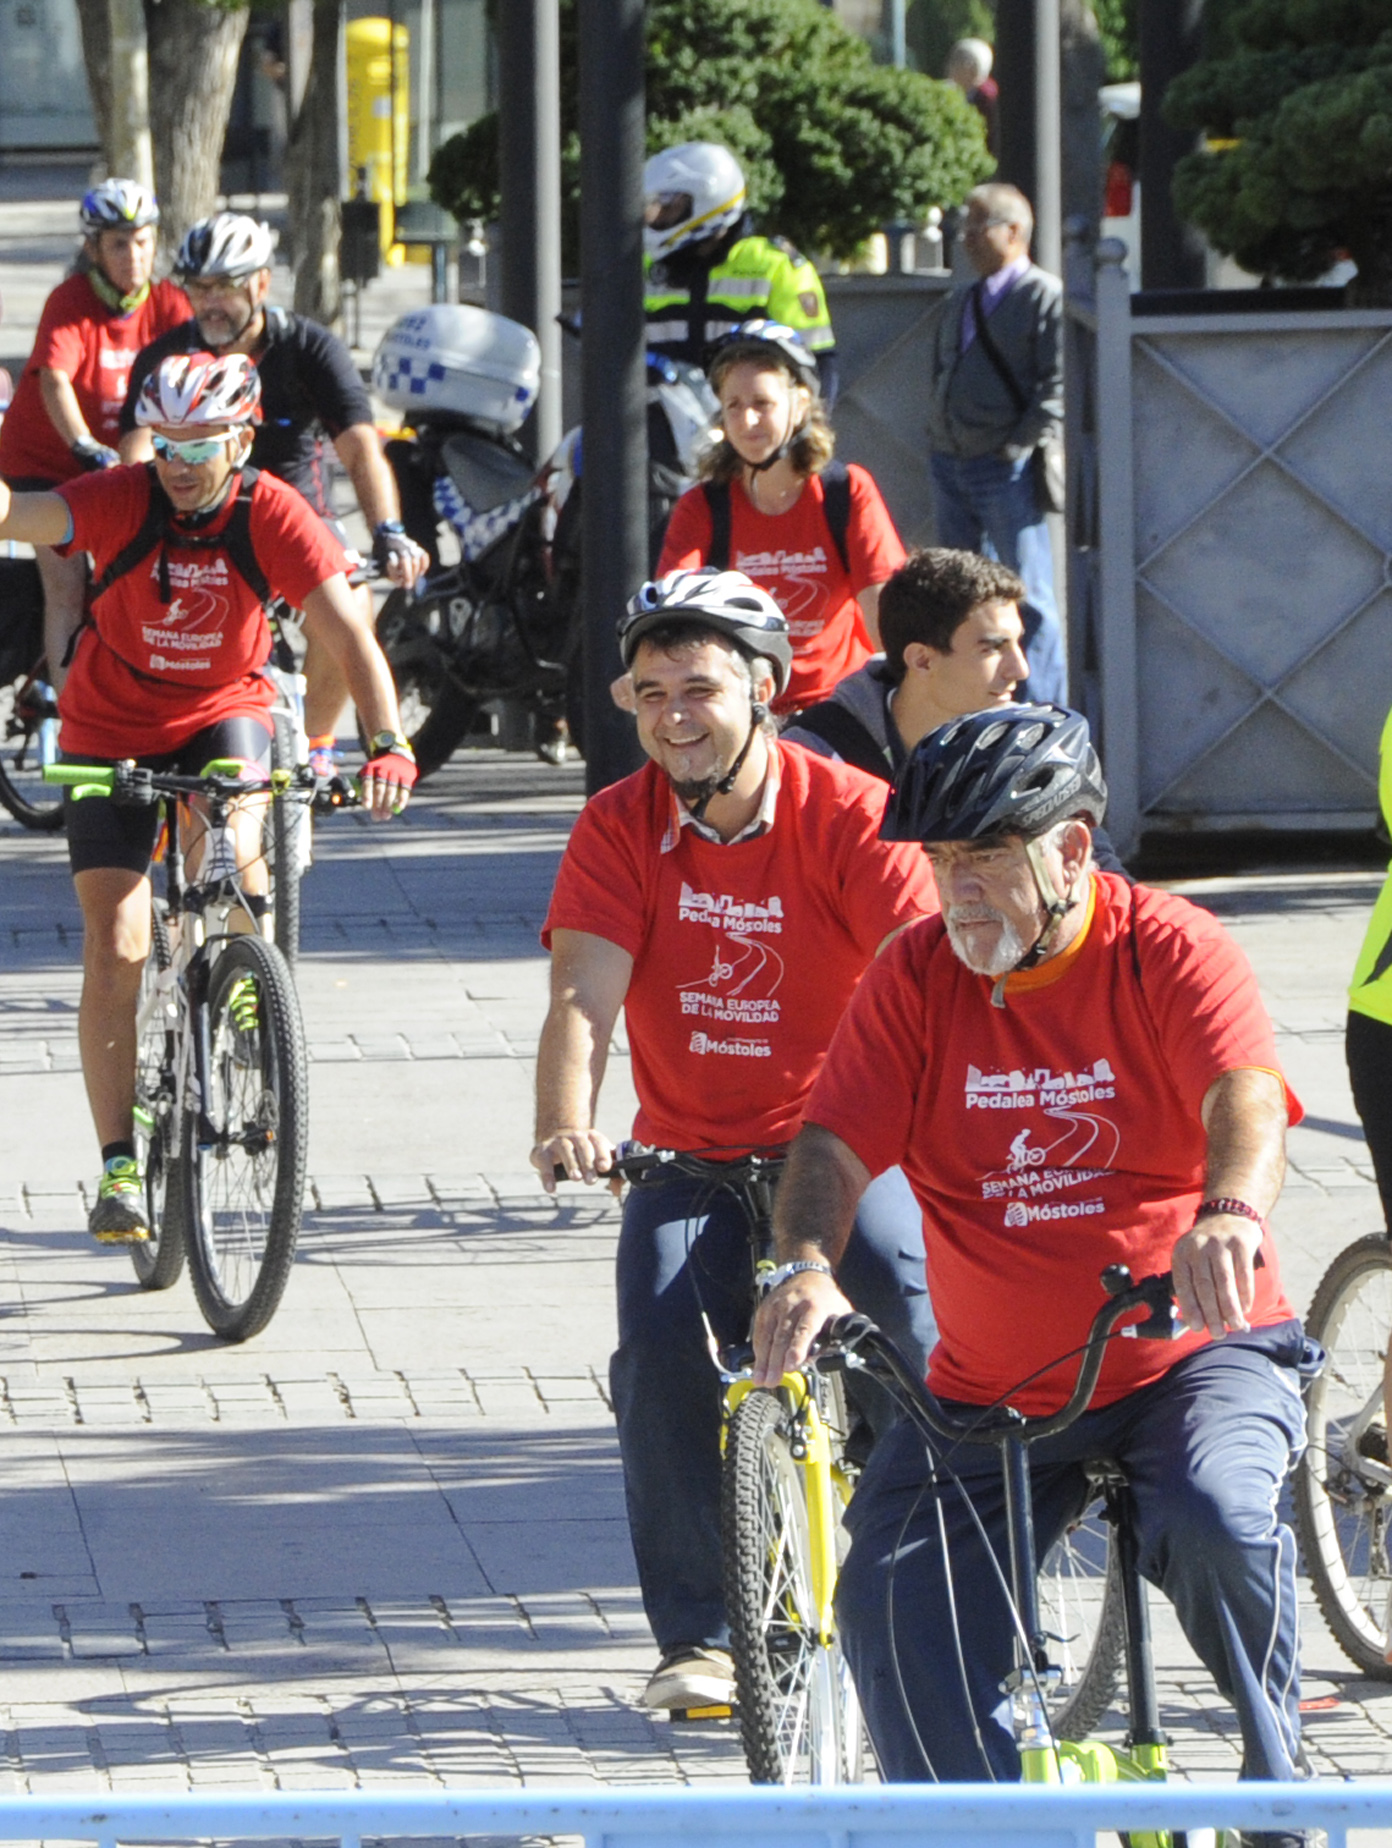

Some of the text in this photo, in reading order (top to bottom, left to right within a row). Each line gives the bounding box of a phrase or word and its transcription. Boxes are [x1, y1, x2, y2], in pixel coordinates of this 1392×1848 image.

[679, 907, 782, 934] Peda Mósoles
[681, 1003, 700, 1015] DE
[714, 1009, 779, 1023] MOVILDAD
[706, 1039, 772, 1058] Móstoles
[965, 1085, 1116, 1109] Pedalea Móstoles
[982, 1171, 1041, 1195] SEMANA
[1029, 1170, 1110, 1197] MOVILID
[1027, 1201, 1106, 1222] Móstoles
